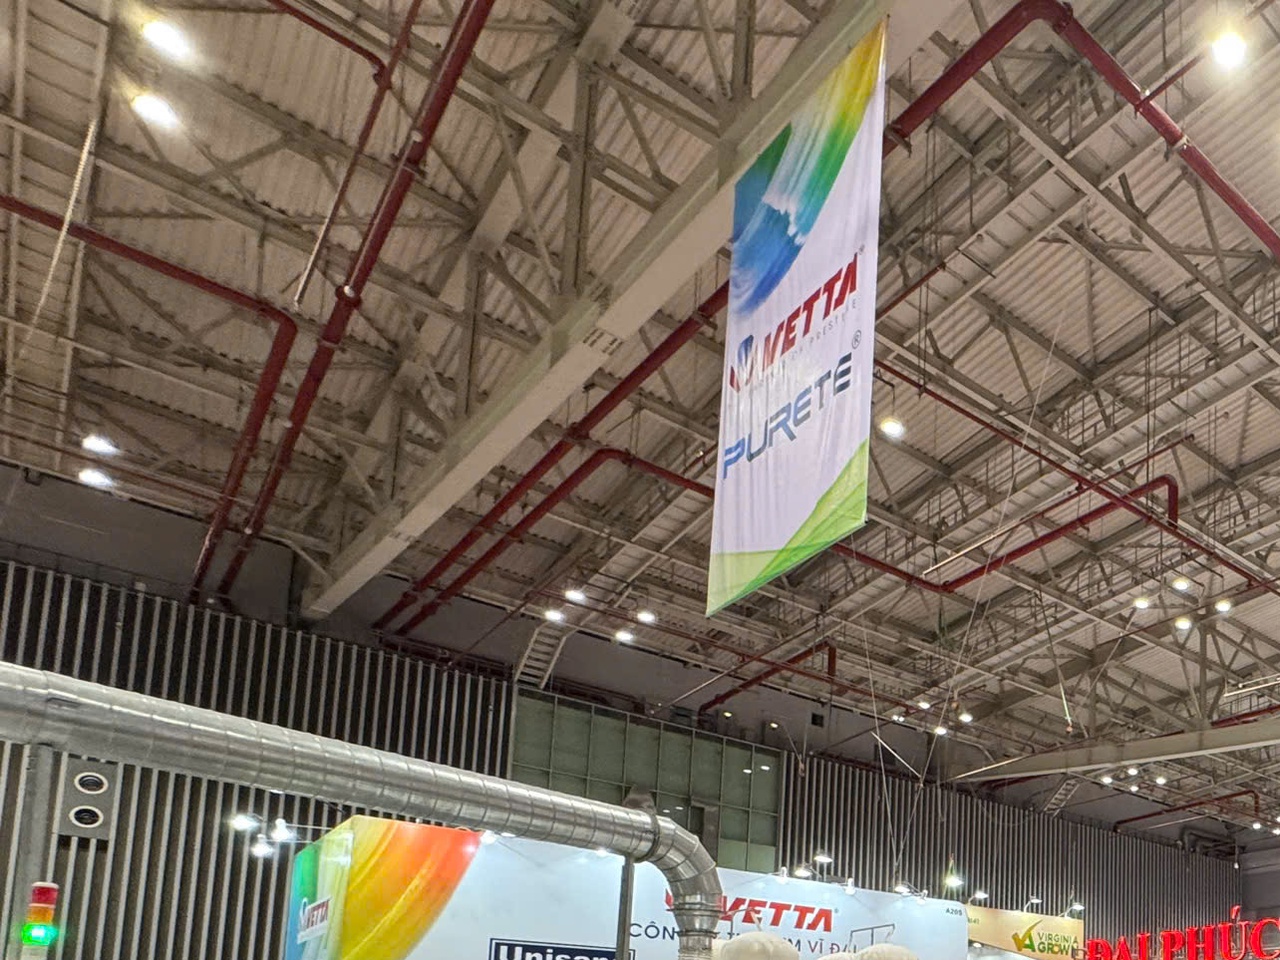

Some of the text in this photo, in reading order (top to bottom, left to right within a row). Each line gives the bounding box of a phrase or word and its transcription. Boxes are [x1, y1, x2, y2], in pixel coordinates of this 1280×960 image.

[763, 253, 858, 371] VETTA
[723, 352, 852, 479] PURETE
[721, 895, 833, 933] VETTA
[629, 921, 676, 940] CÔN
[1037, 932, 1078, 944] VIRGINIA
[1037, 941, 1079, 957] GROWN
